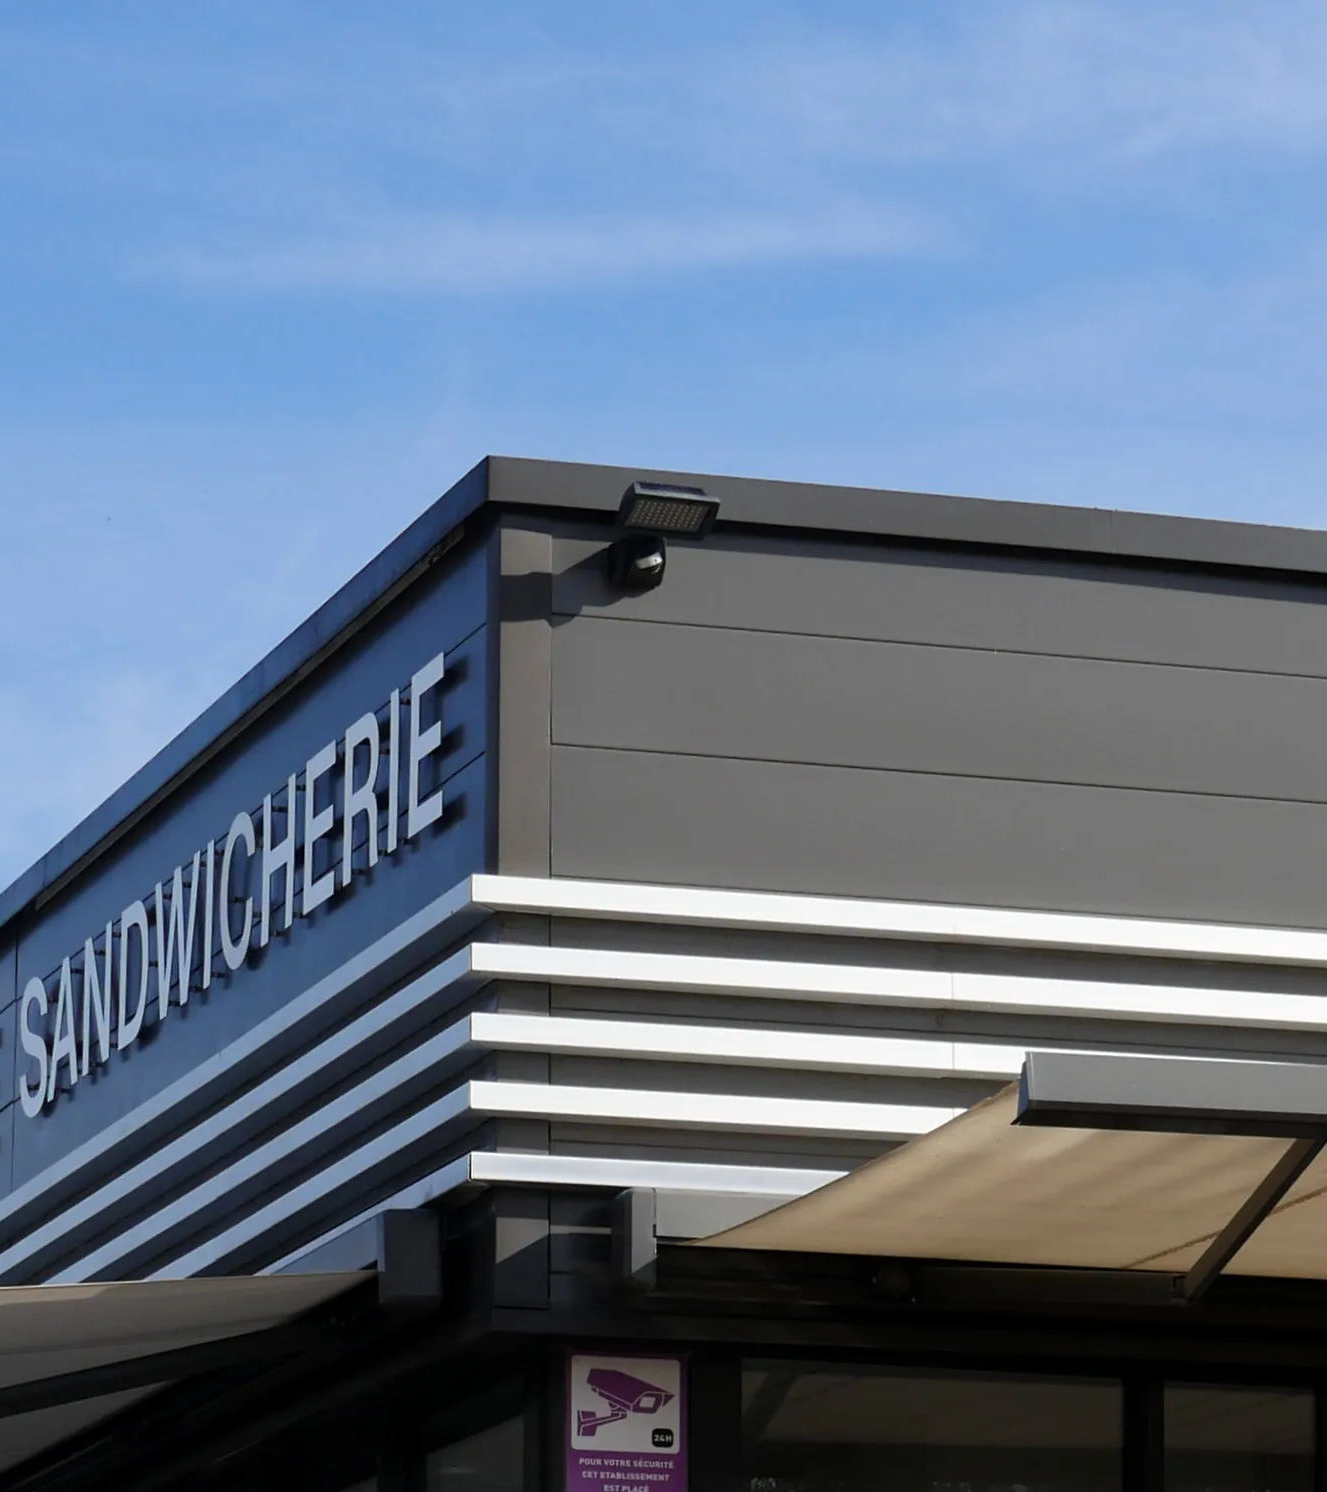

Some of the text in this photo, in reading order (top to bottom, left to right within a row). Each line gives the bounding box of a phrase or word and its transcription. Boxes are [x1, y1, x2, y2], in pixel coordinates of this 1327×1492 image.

[19, 652, 445, 1118] SANDWICHERIE
[653, 1433, 672, 1443] 24H
[578, 1457, 674, 1469] POUR VOTRE SÉCURITÉ
[582, 1470, 670, 1481] CET ETABLISSEMENT
[604, 1484, 650, 1492] EST PLACÉ
